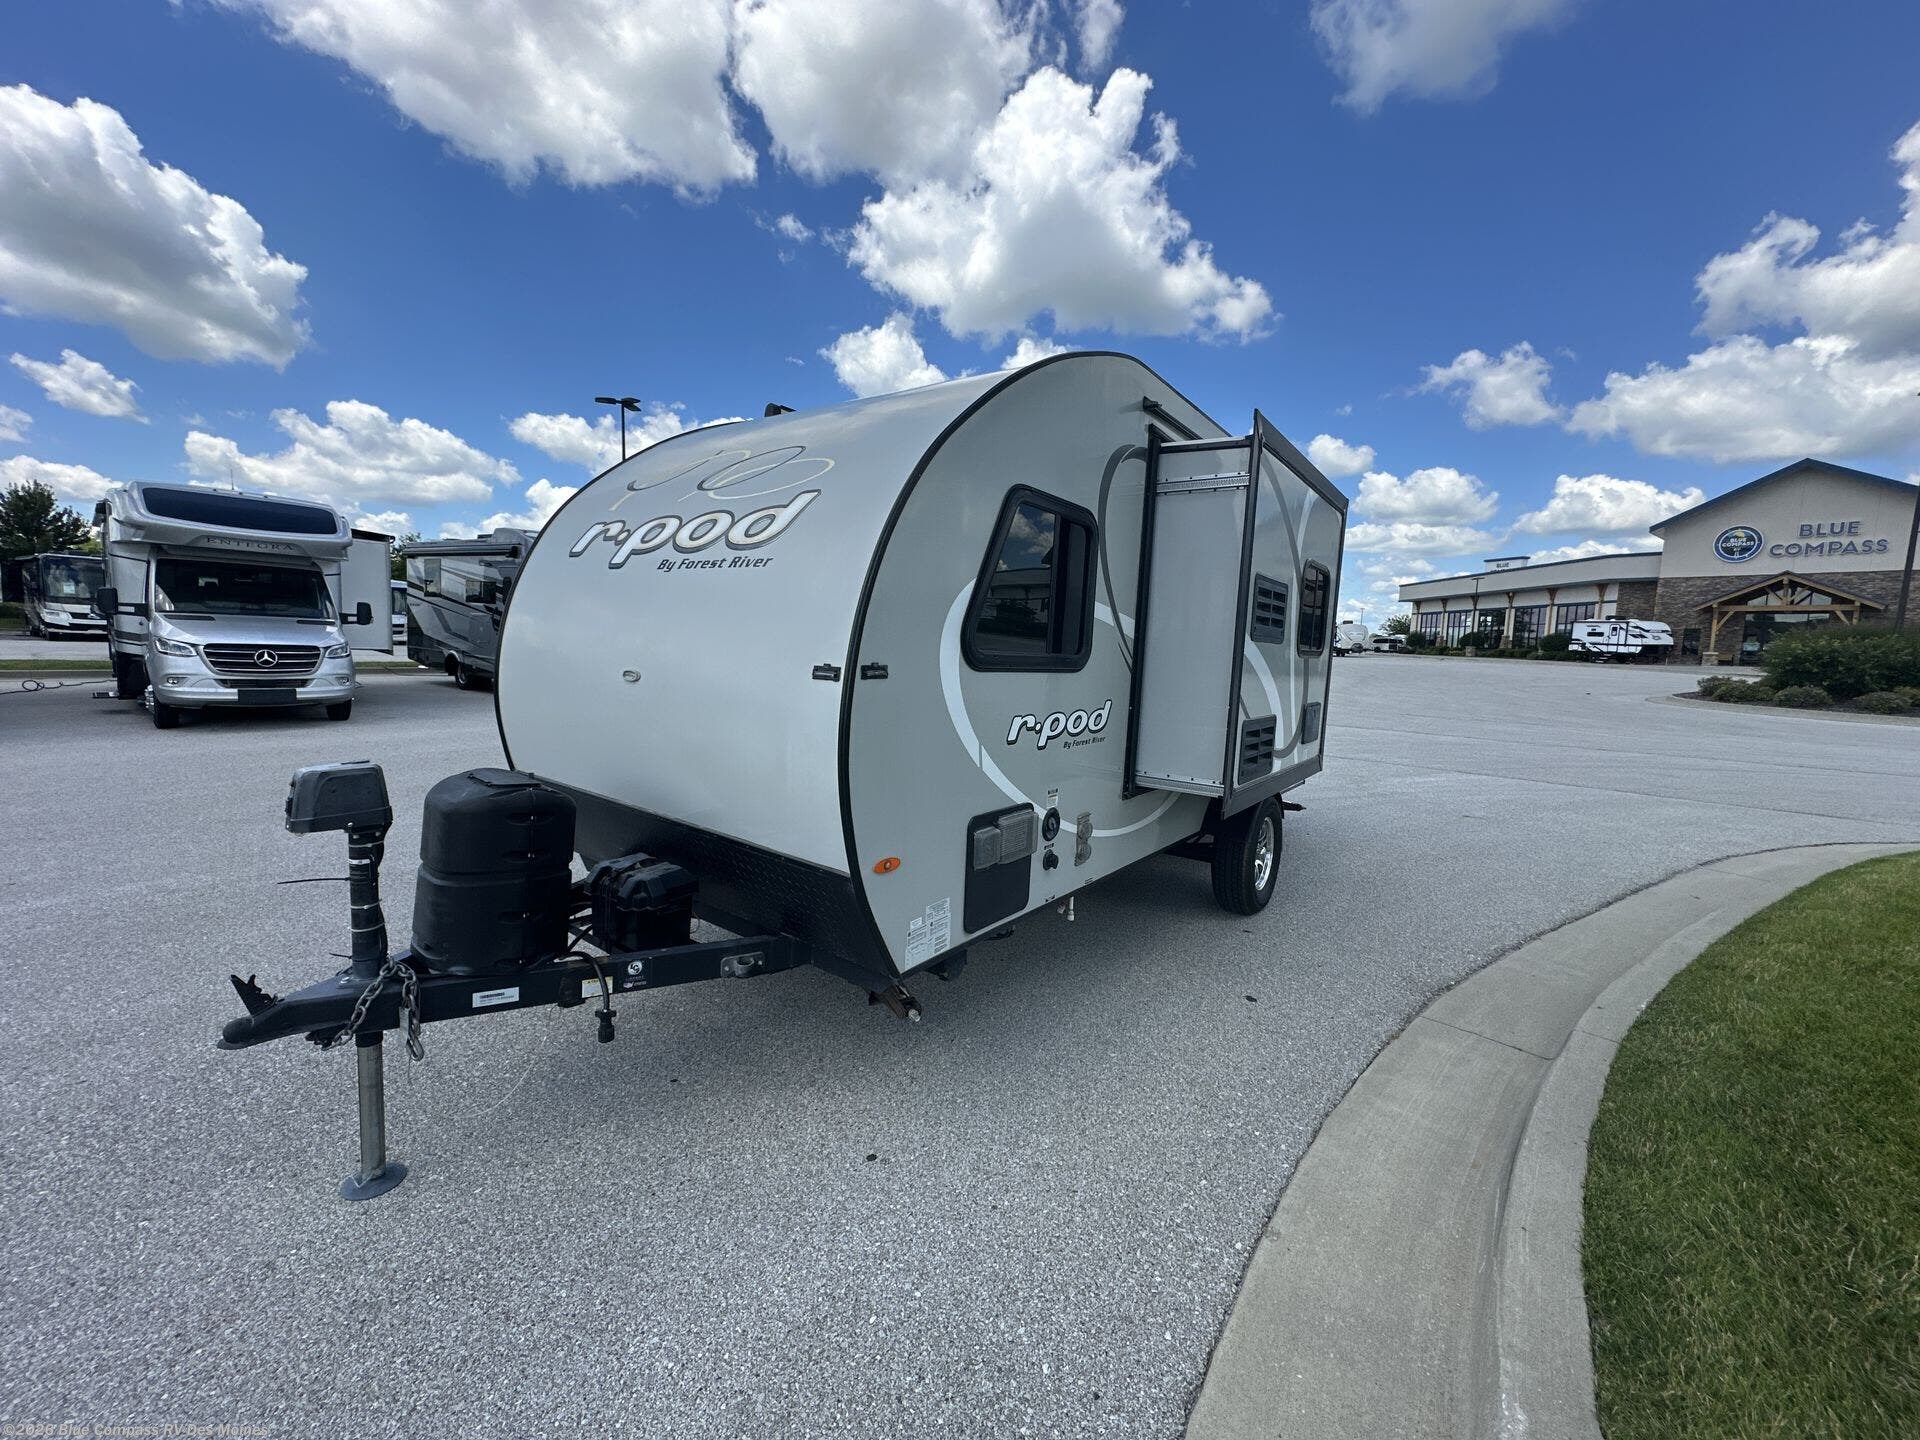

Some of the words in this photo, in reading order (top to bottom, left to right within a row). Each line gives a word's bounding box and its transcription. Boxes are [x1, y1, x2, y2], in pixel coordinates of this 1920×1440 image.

[1799, 520, 1861, 537] BLUE
[1768, 538, 1889, 558] COMPASS
[657, 558, 676, 573] By
[678, 557, 726, 570] Forest
[728, 555, 774, 569] River
[1063, 741, 1071, 749] By
[1072, 739, 1091, 747] Forest
